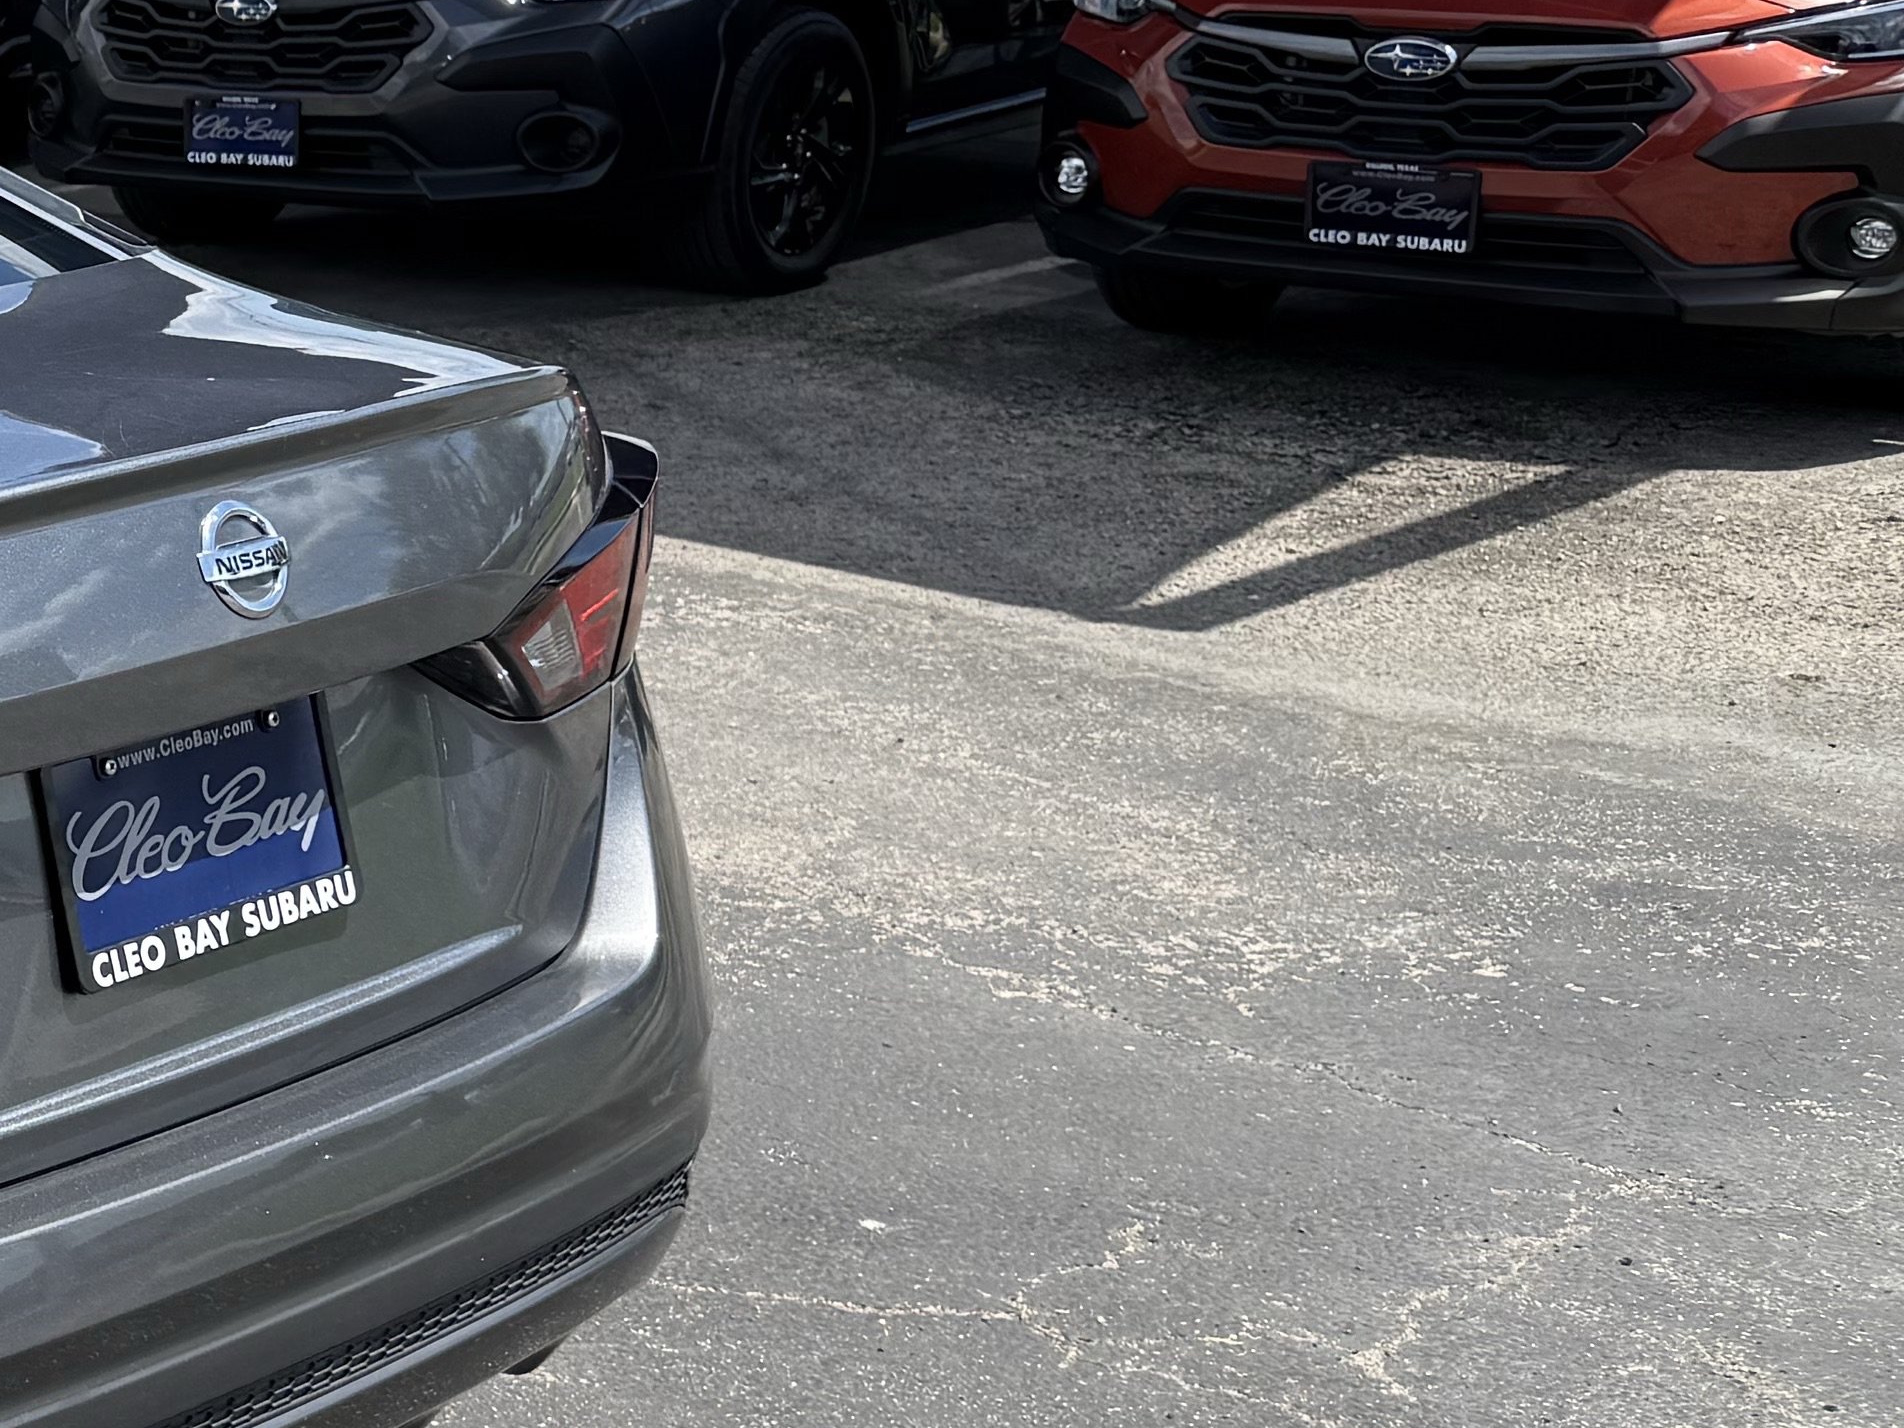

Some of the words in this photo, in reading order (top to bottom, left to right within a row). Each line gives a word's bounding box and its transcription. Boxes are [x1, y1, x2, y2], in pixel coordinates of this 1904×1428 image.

[187, 152, 217, 164] CLEO
[220, 153, 244, 165] BAY
[247, 154, 294, 167] SUBARU
[1316, 182, 1391, 216] Cleo
[1391, 188, 1470, 231] Bay
[1309, 228, 1351, 244] CLEO
[1357, 232, 1391, 247] BAY
[1396, 235, 1467, 254] SUBARU
[214, 540, 289, 575] NISSAN
[117, 717, 254, 769] www.CleoBay.com
[66, 796, 205, 901] Cleo
[202, 765, 325, 852] Bay
[92, 935, 166, 988] CLEO
[174, 910, 230, 960] BAY
[241, 870, 357, 938] SUBARU
